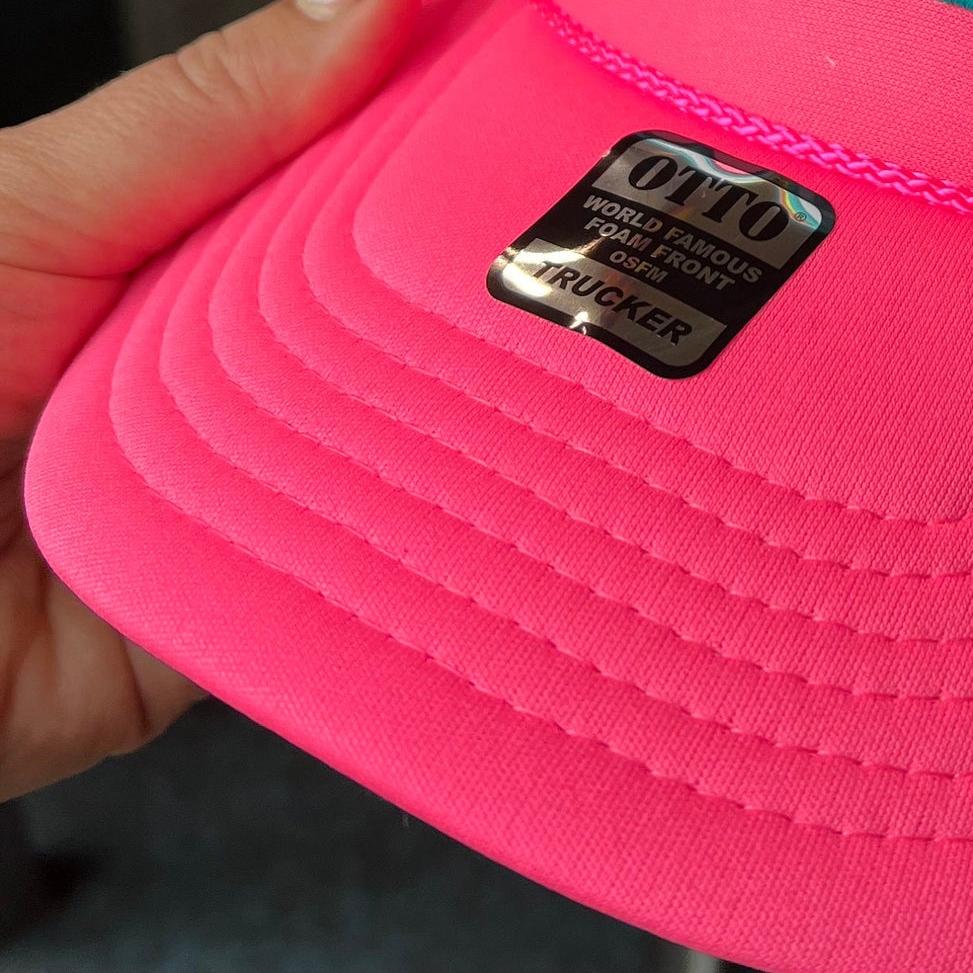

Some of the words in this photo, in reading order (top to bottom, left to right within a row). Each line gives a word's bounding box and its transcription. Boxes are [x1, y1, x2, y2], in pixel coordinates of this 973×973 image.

[583, 194, 660, 234] WORLD
[664, 229, 763, 283] FAMOUS
[628, 155, 790, 242] OTTO
[584, 218, 651, 252] FOAM
[651, 245, 735, 292] FRONT
[609, 250, 668, 284] OSFM
[532, 260, 693, 346] TRUCKER
